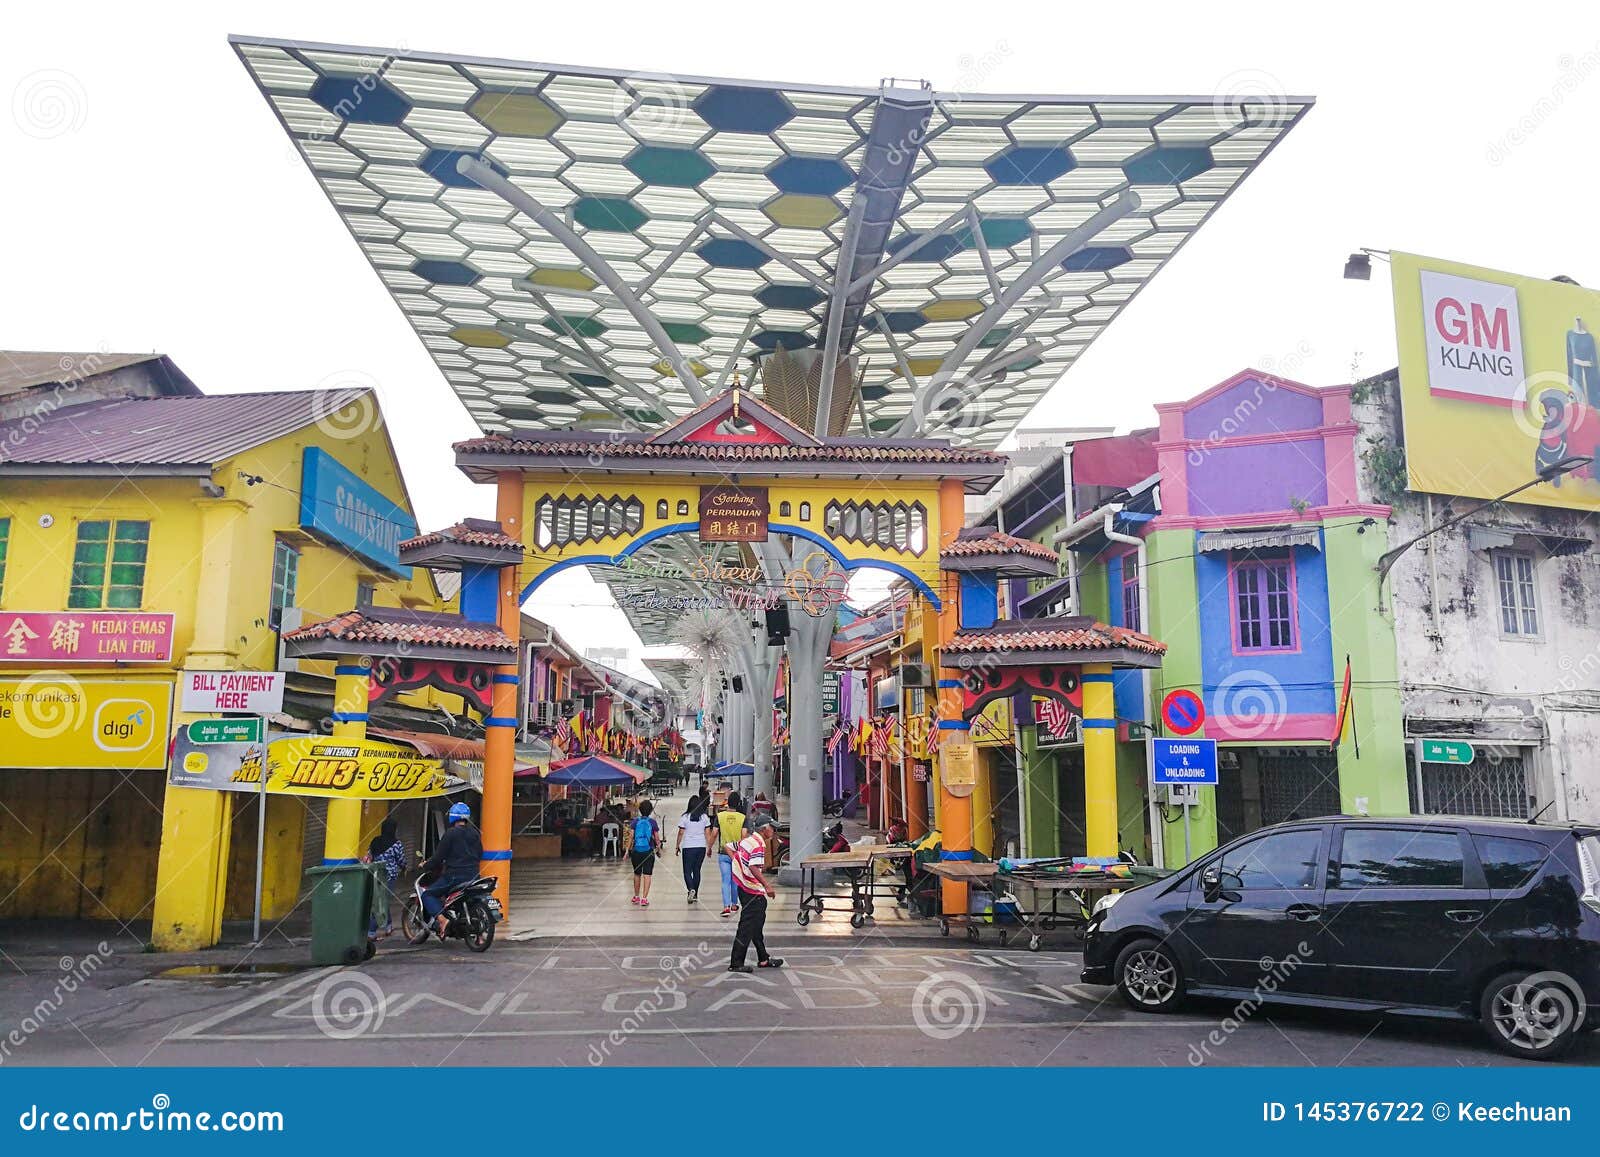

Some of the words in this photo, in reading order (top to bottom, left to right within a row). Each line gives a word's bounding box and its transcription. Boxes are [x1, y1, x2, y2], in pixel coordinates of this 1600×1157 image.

[1435, 297, 1511, 352] GM
[1441, 346, 1513, 376] KLANG
[706, 509, 761, 517] PERPADUAN
[335, 485, 401, 557] SAMSUNG
[710, 521, 757, 536] 团结门
[91, 620, 126, 635] KEDAI
[132, 620, 166, 635] EMAS
[98, 639, 127, 654] LIAN
[132, 640, 156, 654] FOH
[193, 674, 216, 691] BILL
[220, 675, 275, 692] PAYMENT
[215, 692, 248, 708] HERE
[103, 721, 133, 739] digi
[201, 725, 218, 735] Jalan
[324, 746, 360, 757] INTERNET
[1169, 745, 1200, 754] LOADING
[1182, 757, 1189, 766] &
[290, 759, 358, 790] RM3
[1165, 768, 1205, 778] UNLOADING
[332, 881, 343, 894] 2
